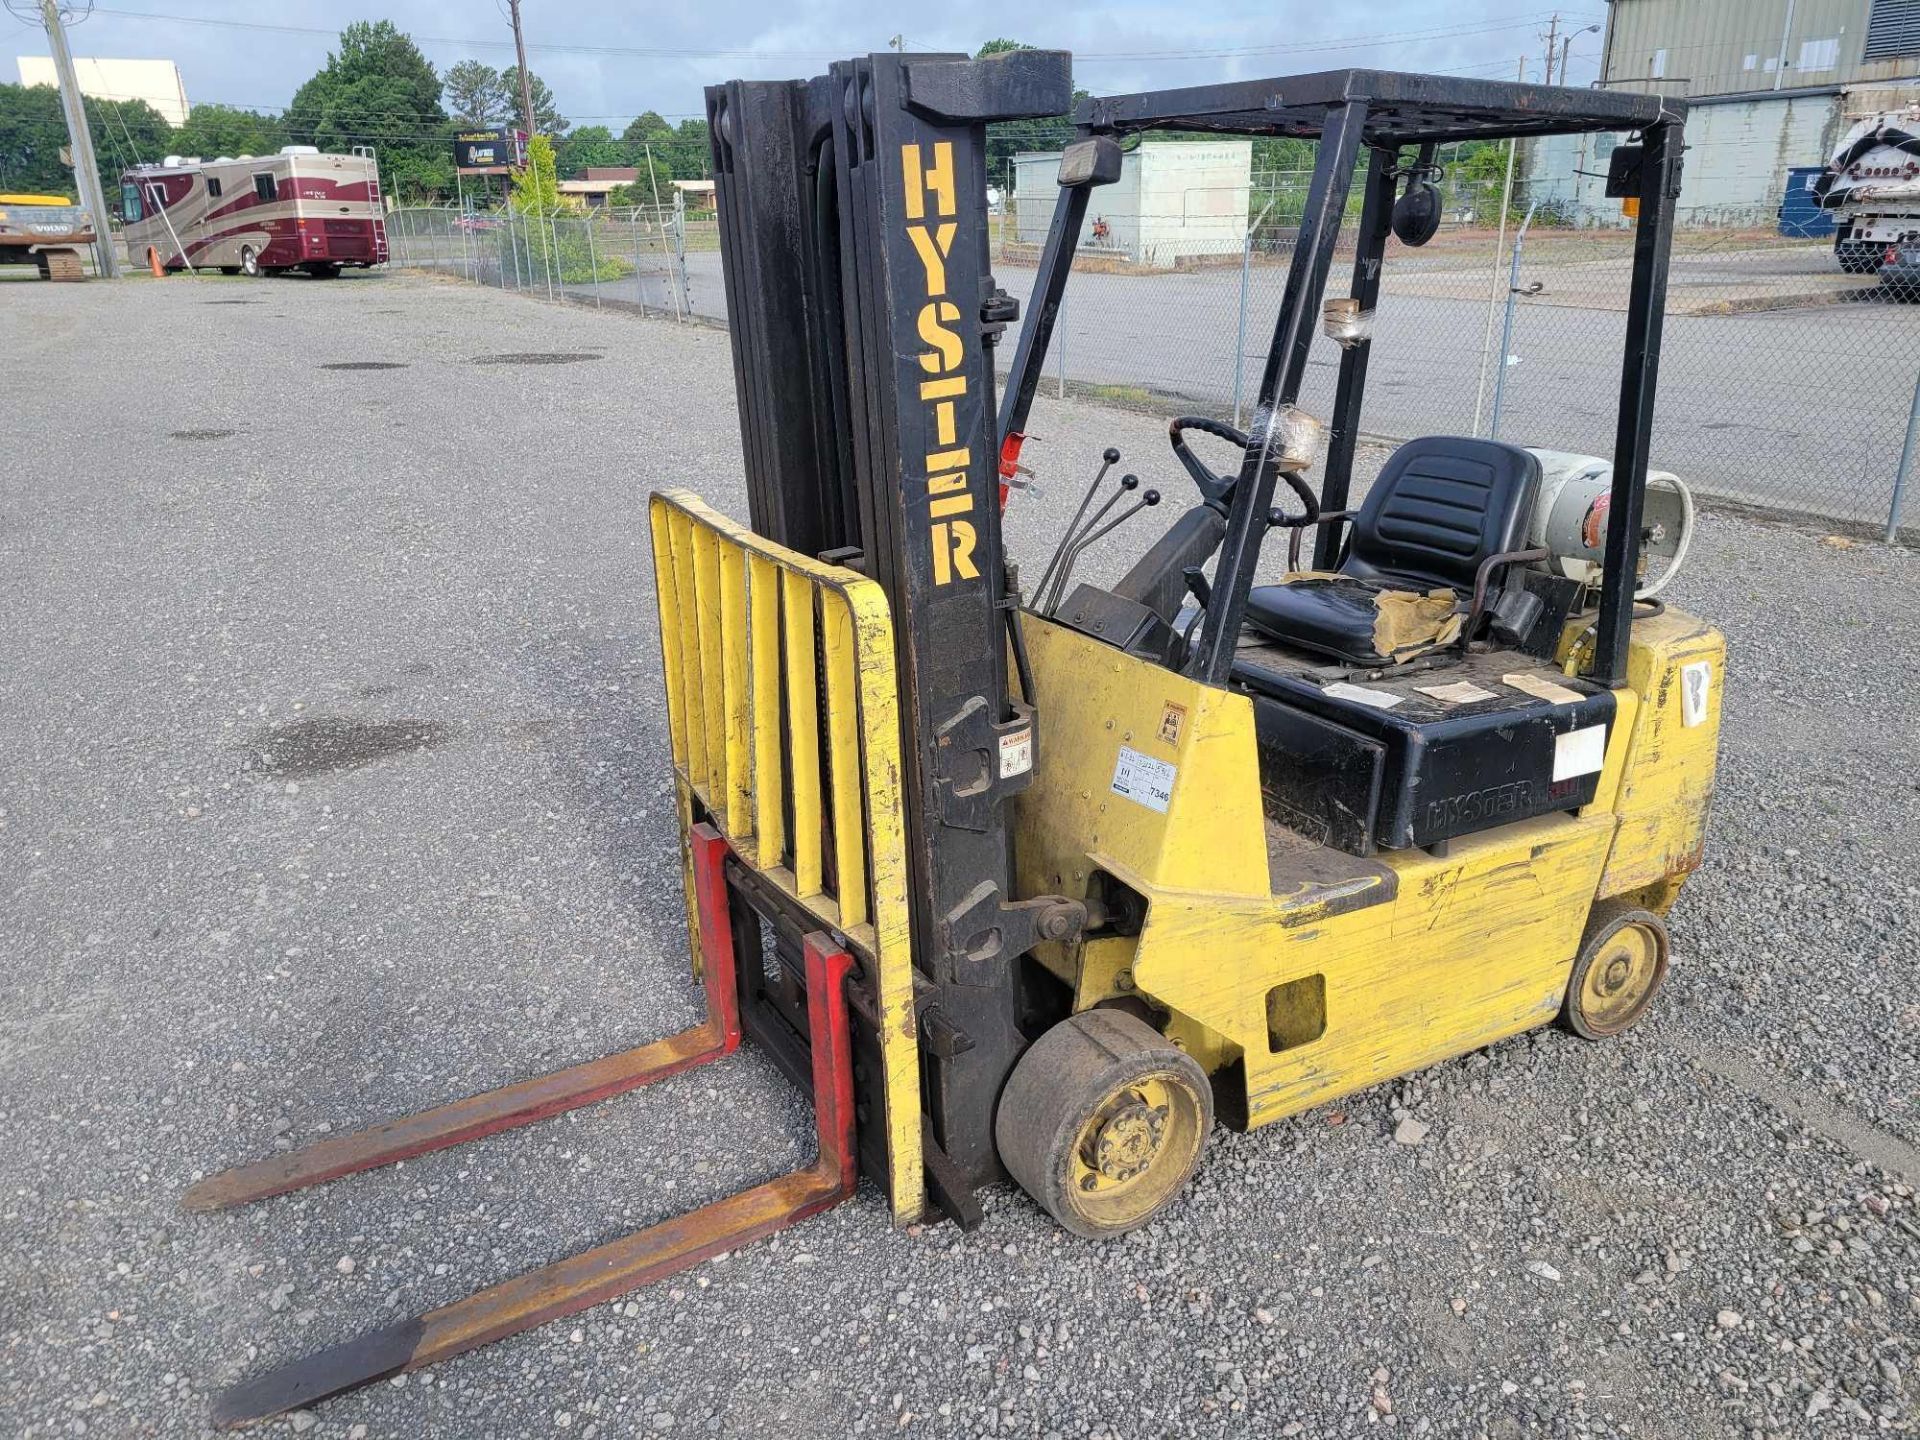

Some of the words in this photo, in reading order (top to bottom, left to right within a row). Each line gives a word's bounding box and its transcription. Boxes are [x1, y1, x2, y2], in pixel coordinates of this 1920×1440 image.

[902, 142, 980, 586] HYSTER
[1150, 786, 1170, 802] 7346
[1425, 780, 1535, 832] HYSTER
